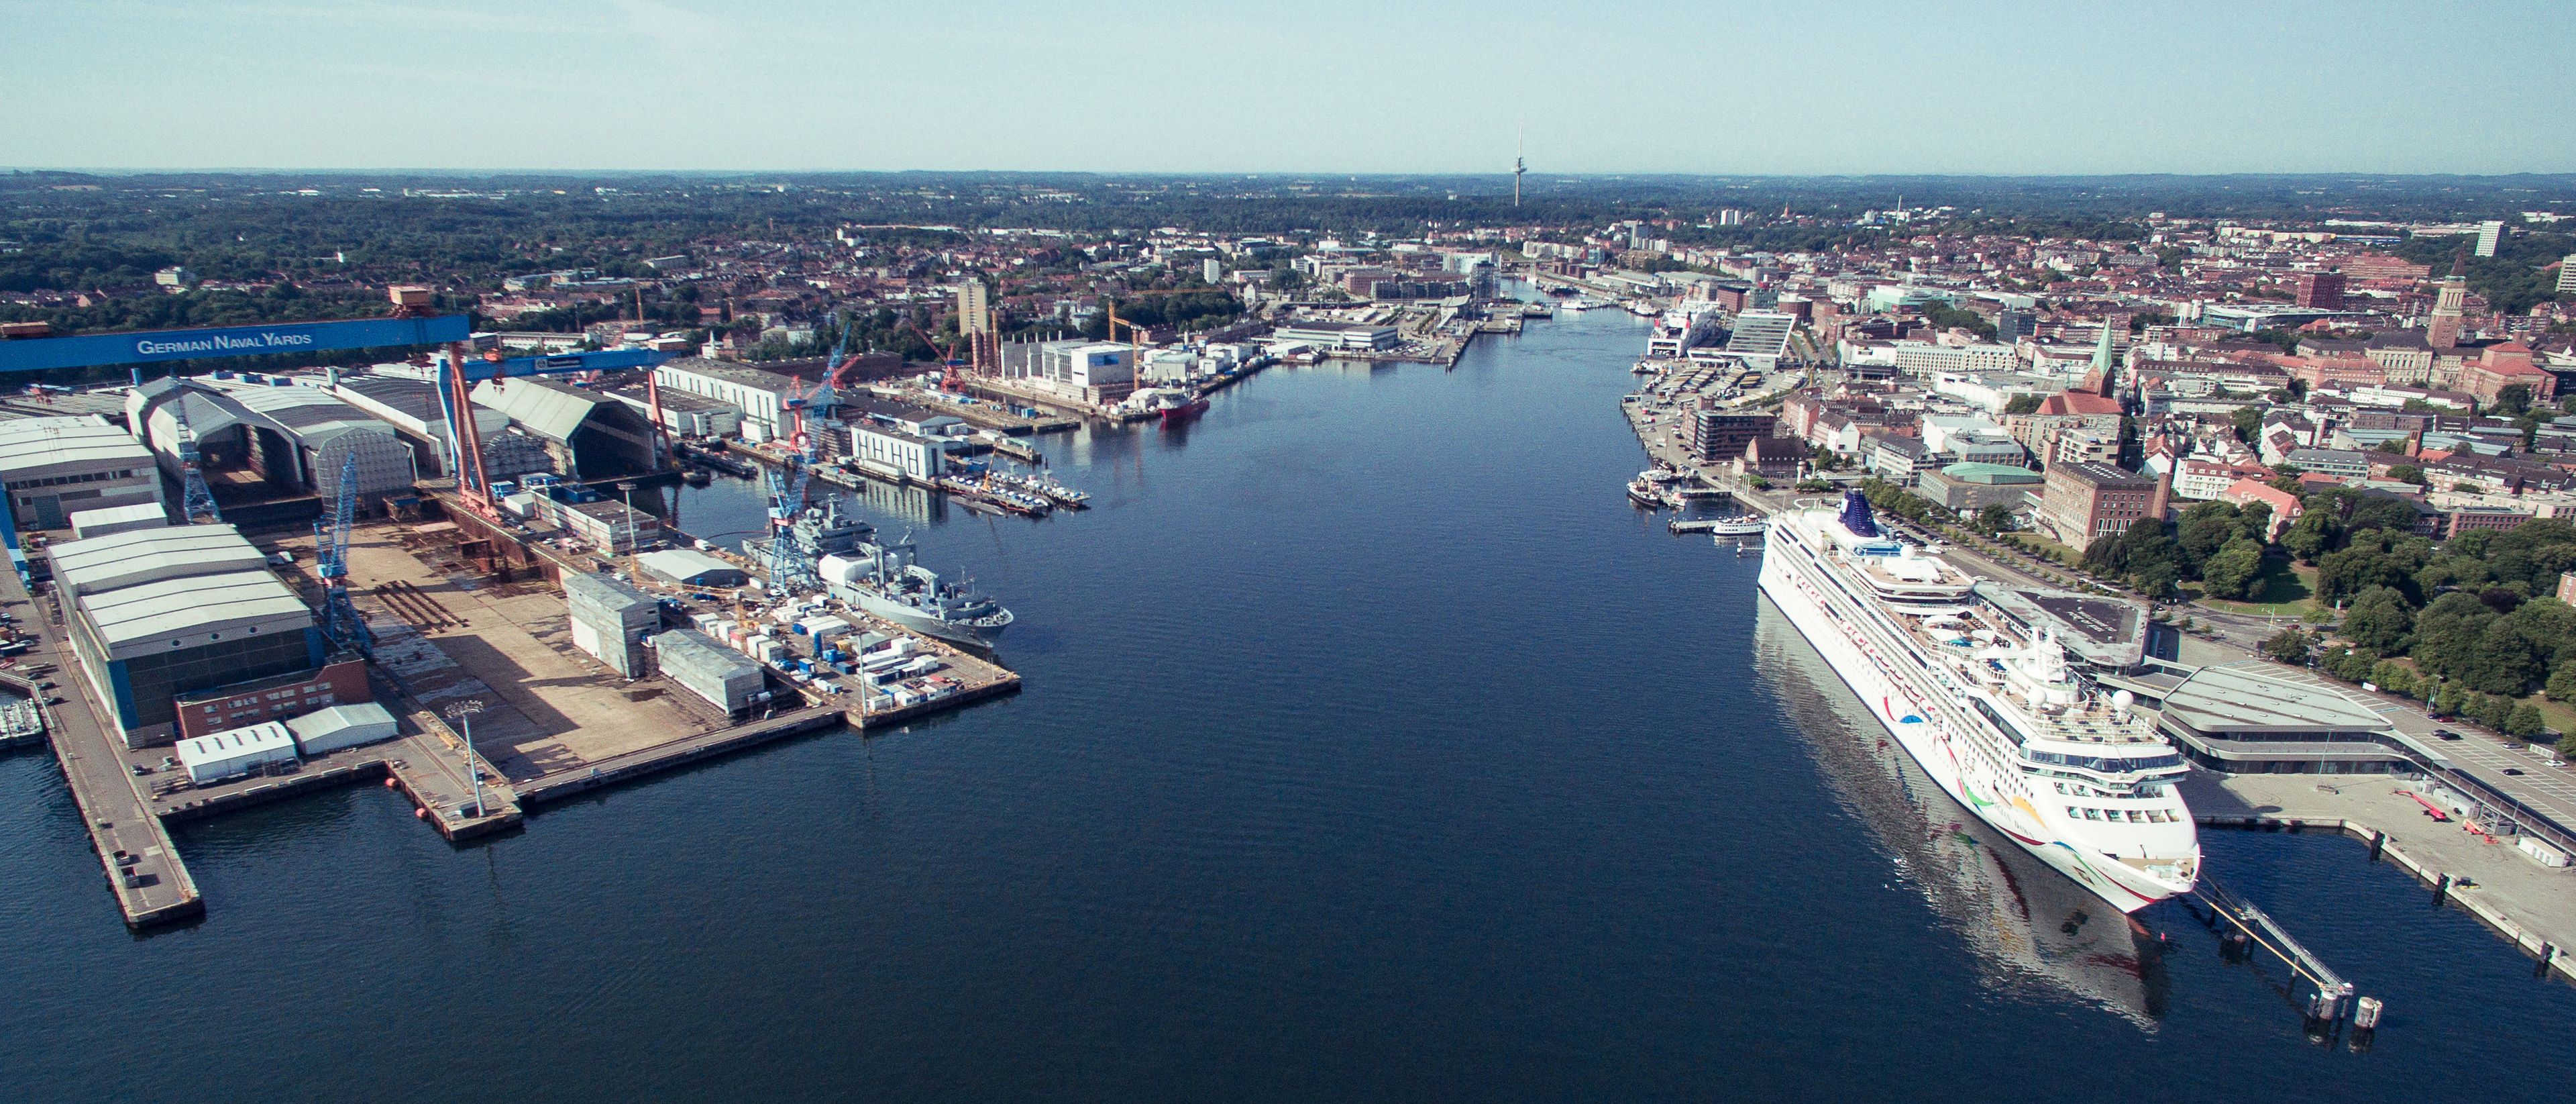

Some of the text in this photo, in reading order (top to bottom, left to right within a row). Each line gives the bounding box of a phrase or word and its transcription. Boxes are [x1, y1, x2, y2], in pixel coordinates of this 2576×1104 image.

[137, 332, 312, 354] GERMAN NAVAL YARDS
